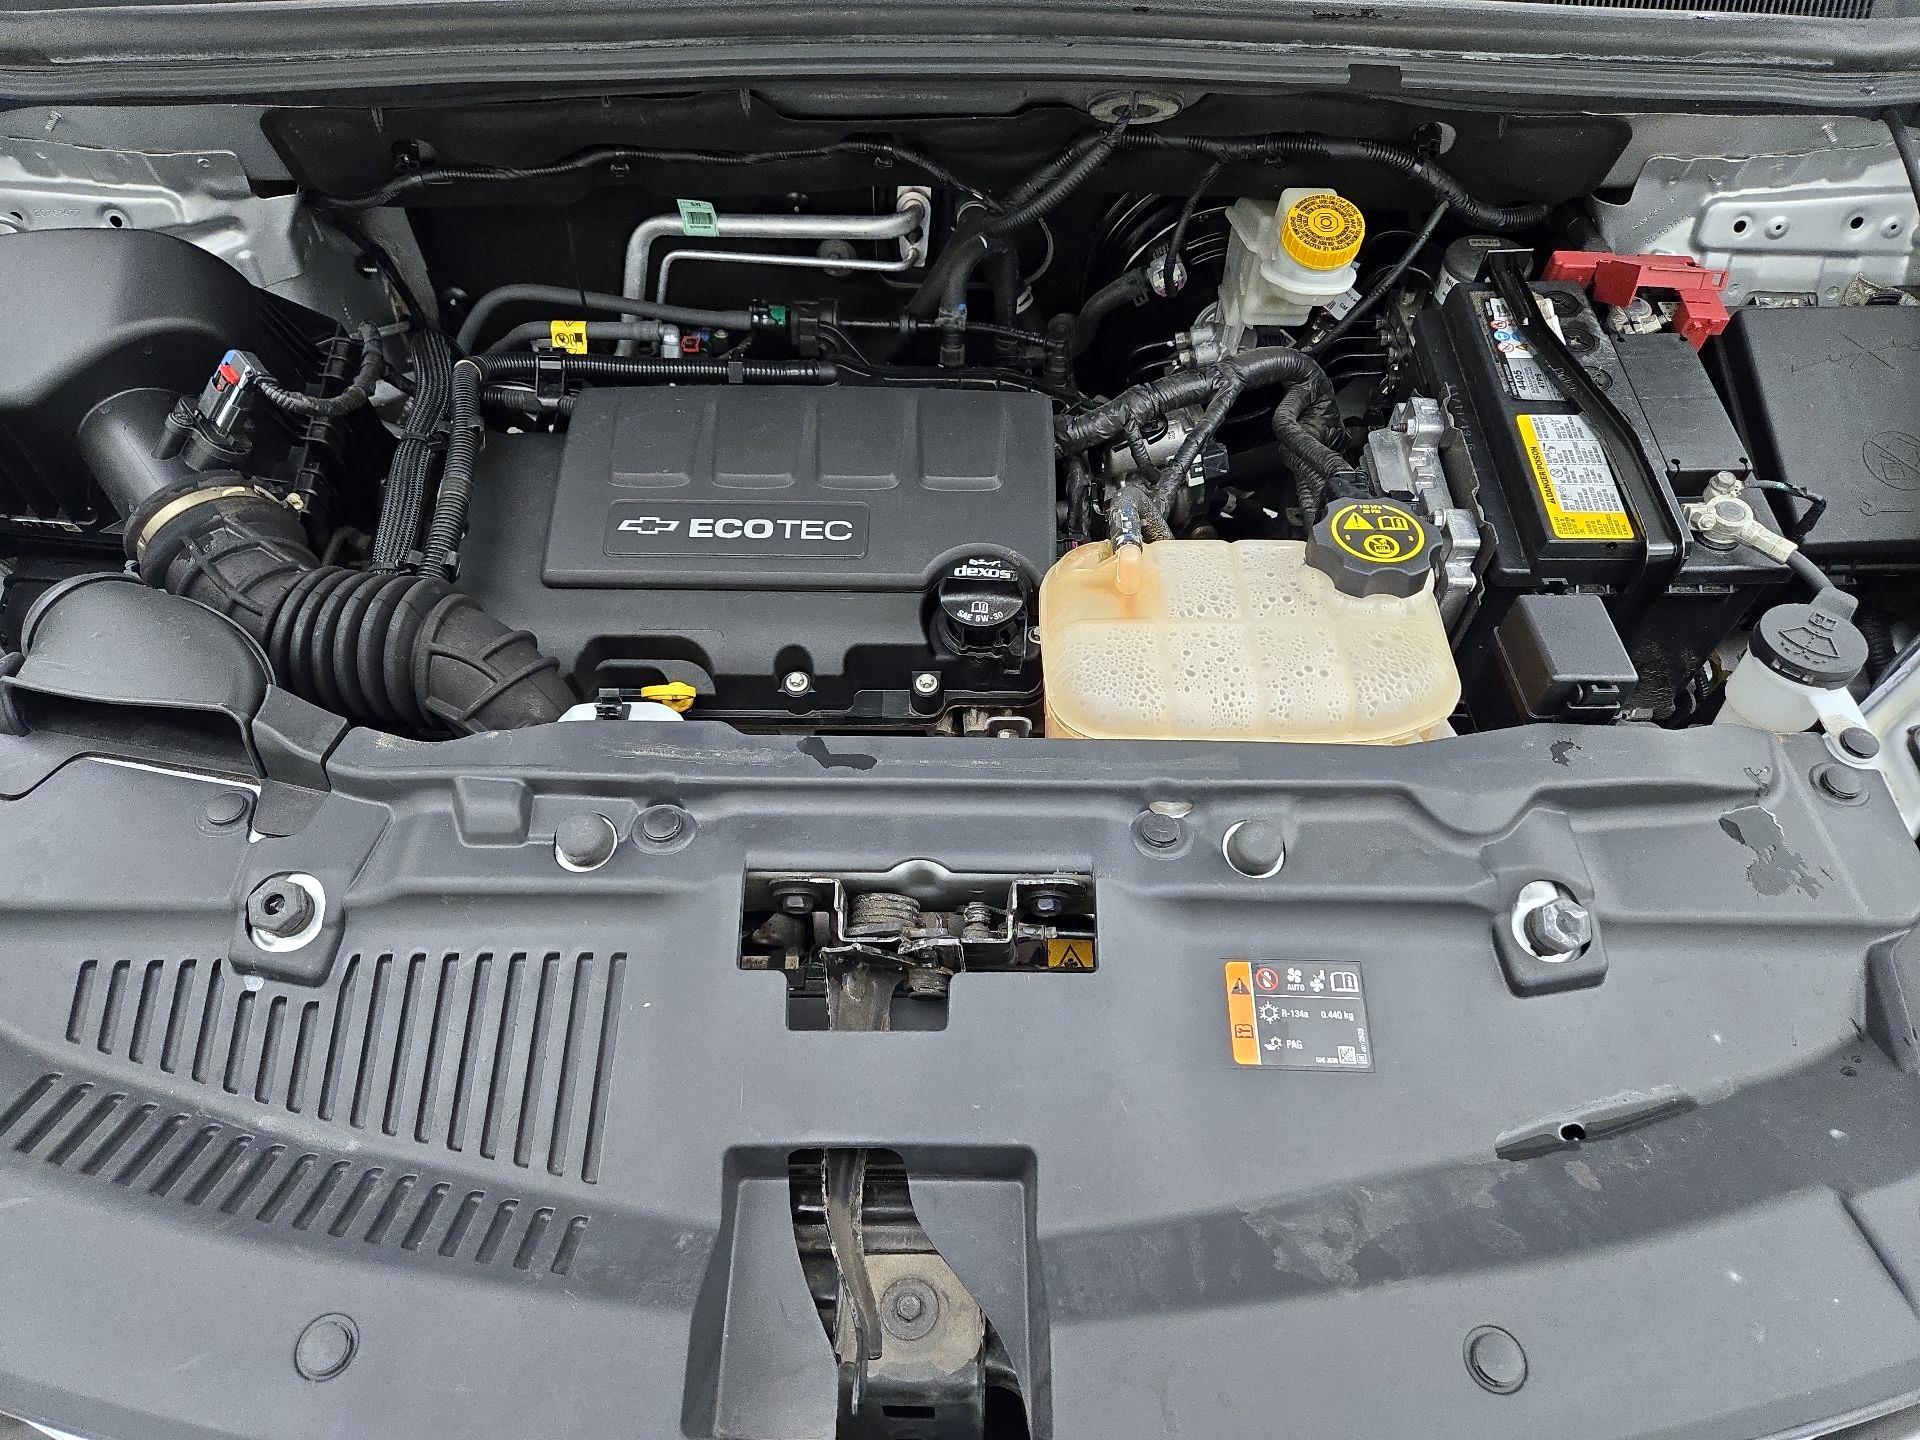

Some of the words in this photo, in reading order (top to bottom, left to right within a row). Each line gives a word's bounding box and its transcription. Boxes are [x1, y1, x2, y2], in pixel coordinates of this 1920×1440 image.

[1513, 370, 1526, 391] 4405
[688, 518, 853, 541] ECOTEC
[956, 610, 973, 622] SAE
[975, 611, 1004, 622] 5W-30
[1287, 984, 1306, 992] AUTO
[1282, 1009, 1310, 1019] R-134a
[1321, 1010, 1342, 1019] 0.440
[1344, 1011, 1354, 1022] kg
[1286, 1040, 1303, 1049] PAG
